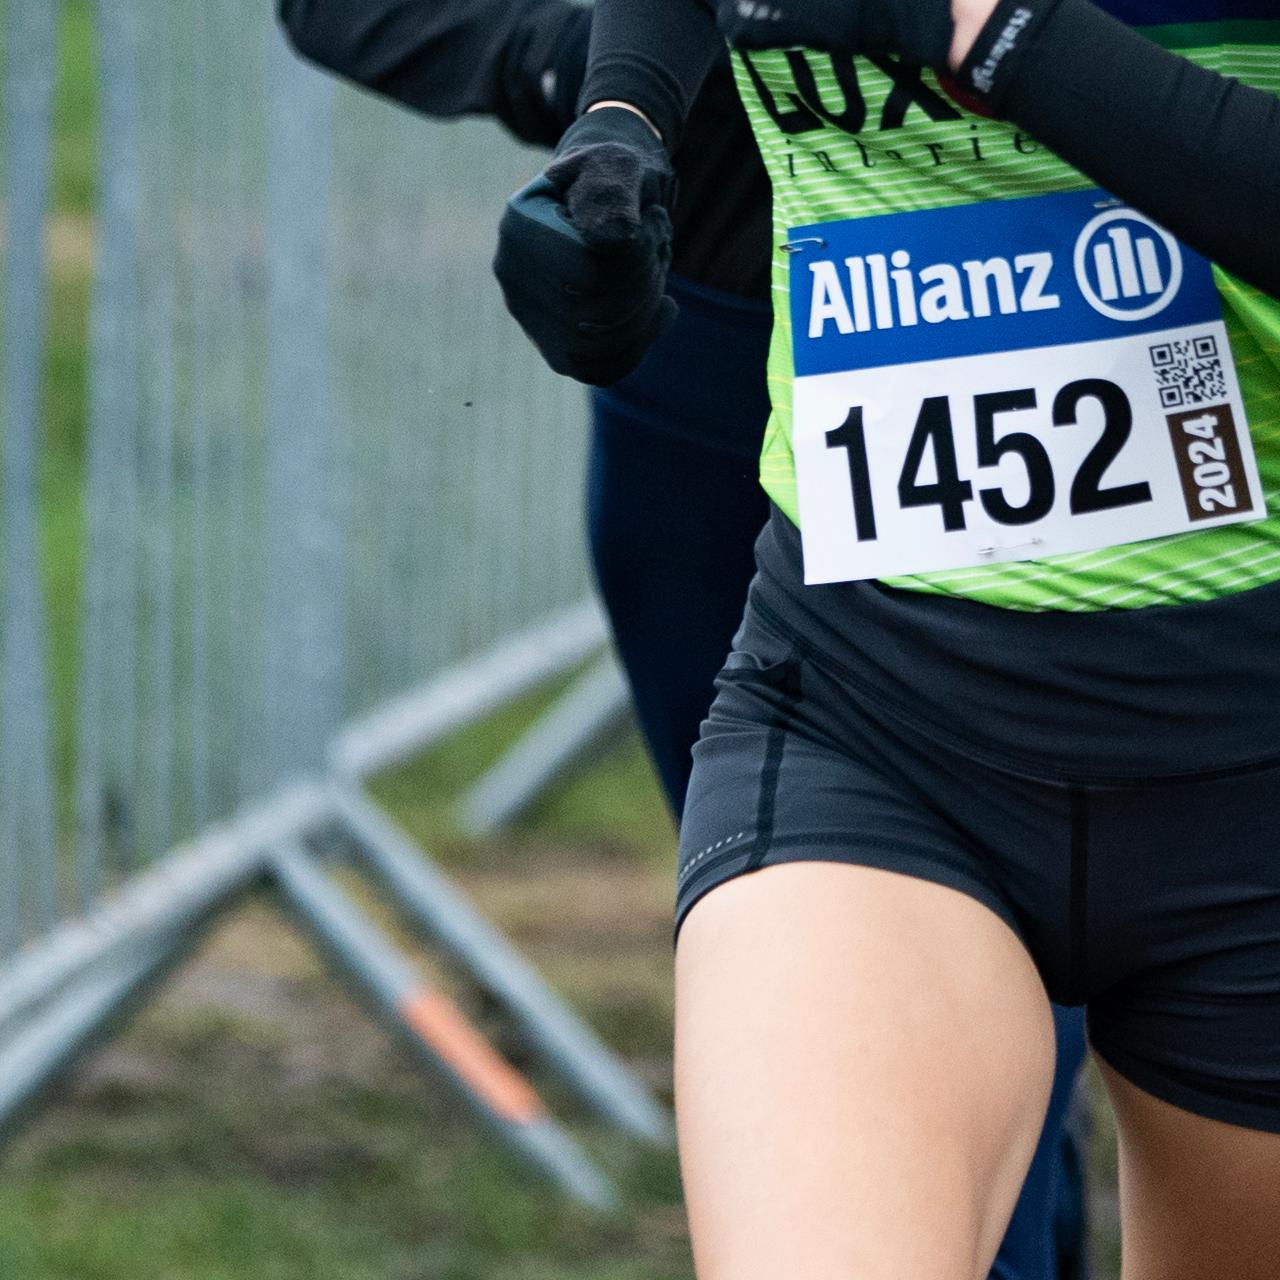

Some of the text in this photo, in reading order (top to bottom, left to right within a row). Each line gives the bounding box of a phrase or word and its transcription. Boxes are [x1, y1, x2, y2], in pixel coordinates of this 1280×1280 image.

[808, 249, 1061, 339] Allianz
[825, 378, 1152, 542] 1452
[1187, 414, 1237, 513] 2024
